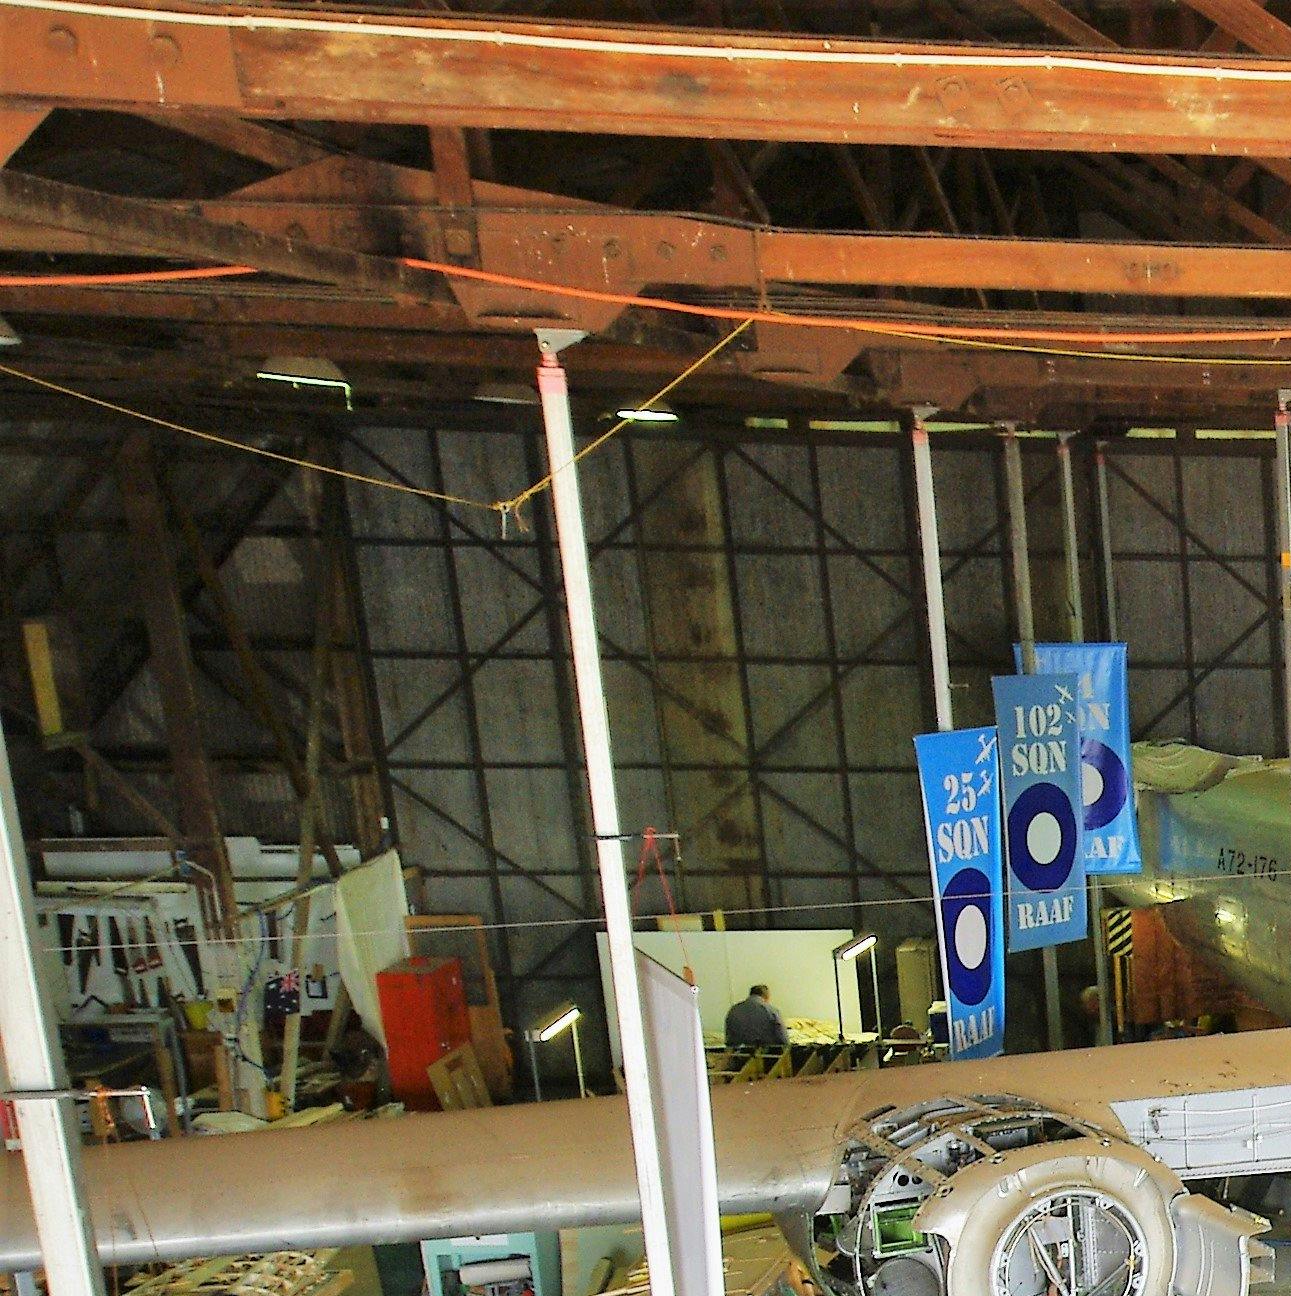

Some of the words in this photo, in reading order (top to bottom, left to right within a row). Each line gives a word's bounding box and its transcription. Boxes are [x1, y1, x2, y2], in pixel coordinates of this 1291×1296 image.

[1014, 704, 1064, 739] 102
[1011, 740, 1067, 777] SQN
[943, 771, 978, 815] 25
[937, 814, 990, 864] SQN
[1217, 847, 1277, 882] A72-176
[1017, 895, 1075, 930] RAAF
